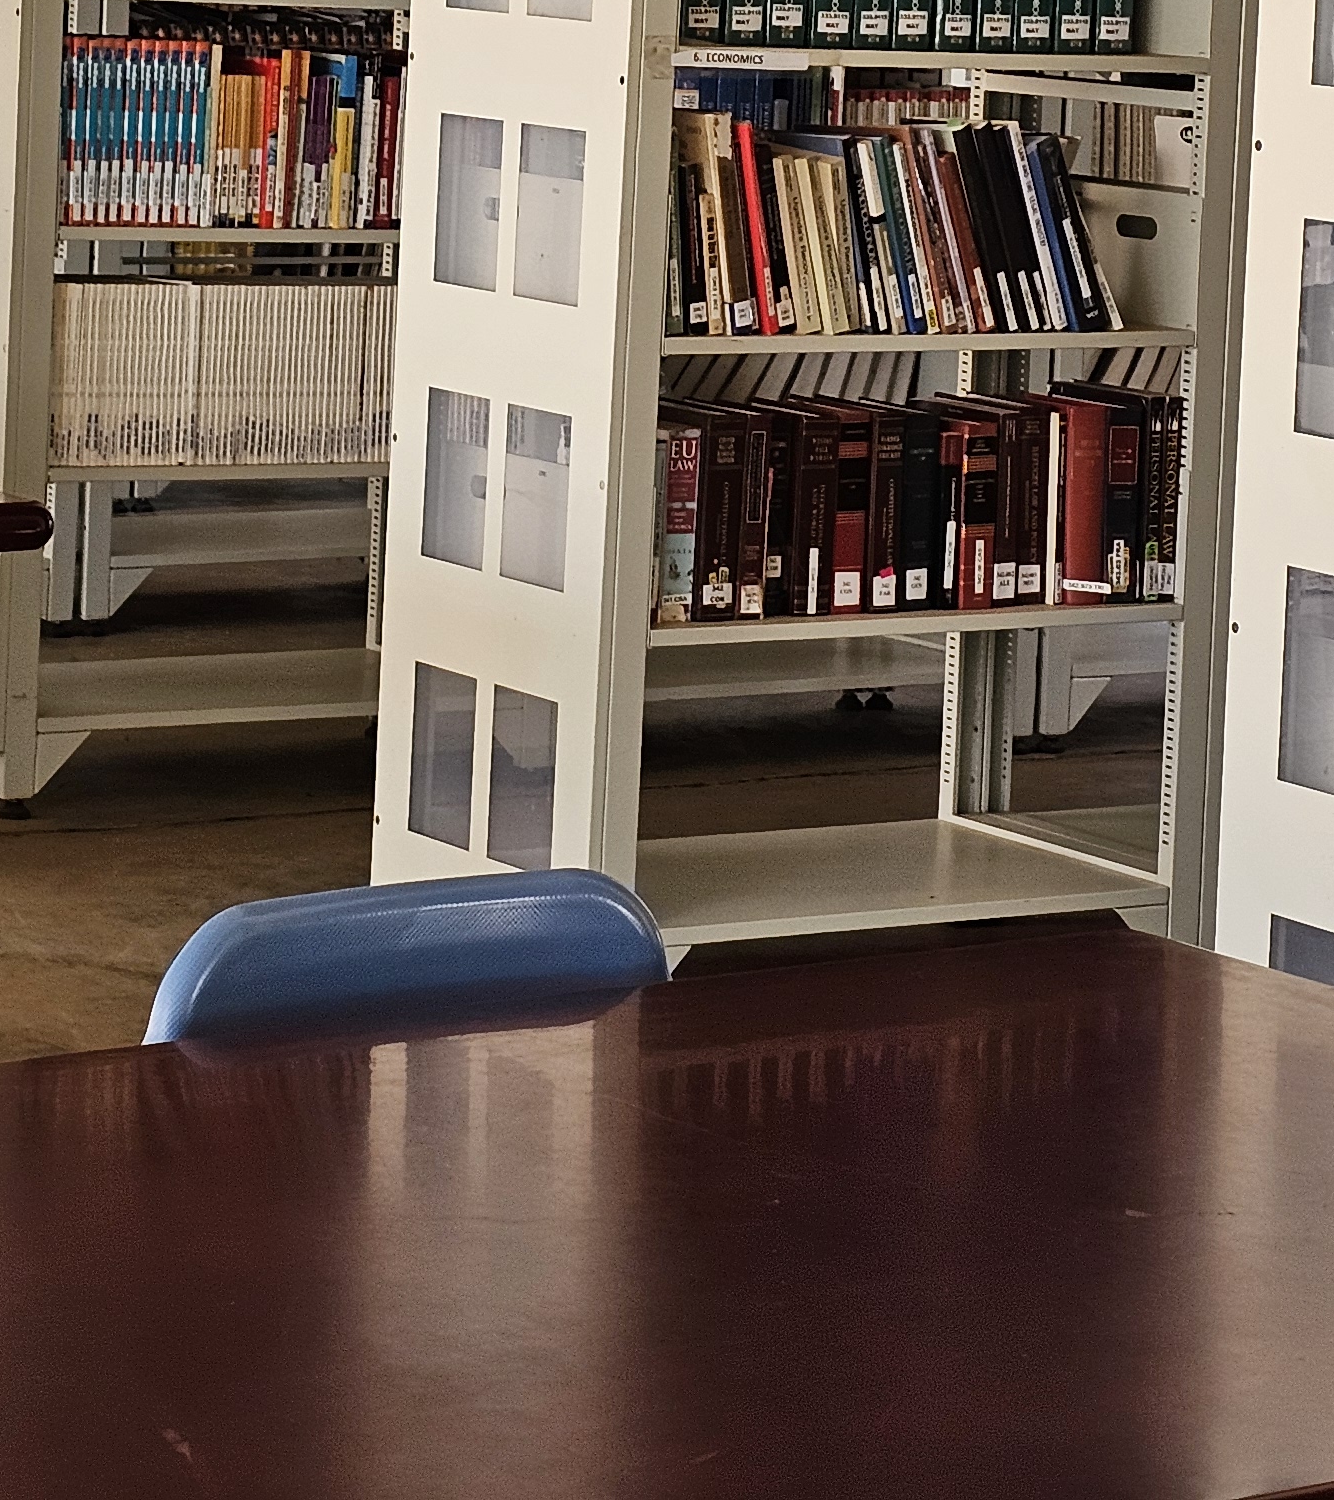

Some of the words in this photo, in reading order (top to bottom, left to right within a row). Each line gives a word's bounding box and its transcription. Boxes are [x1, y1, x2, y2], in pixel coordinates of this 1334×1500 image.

[694, 51, 702, 62] 6.
[706, 52, 764, 65] ECONOMICS
[671, 440, 696, 459] EU
[670, 460, 696, 471] LAW
[1150, 433, 1160, 514] PERSONAL
[1165, 432, 1177, 513] PERSONAL
[1163, 522, 1174, 558] LAW
